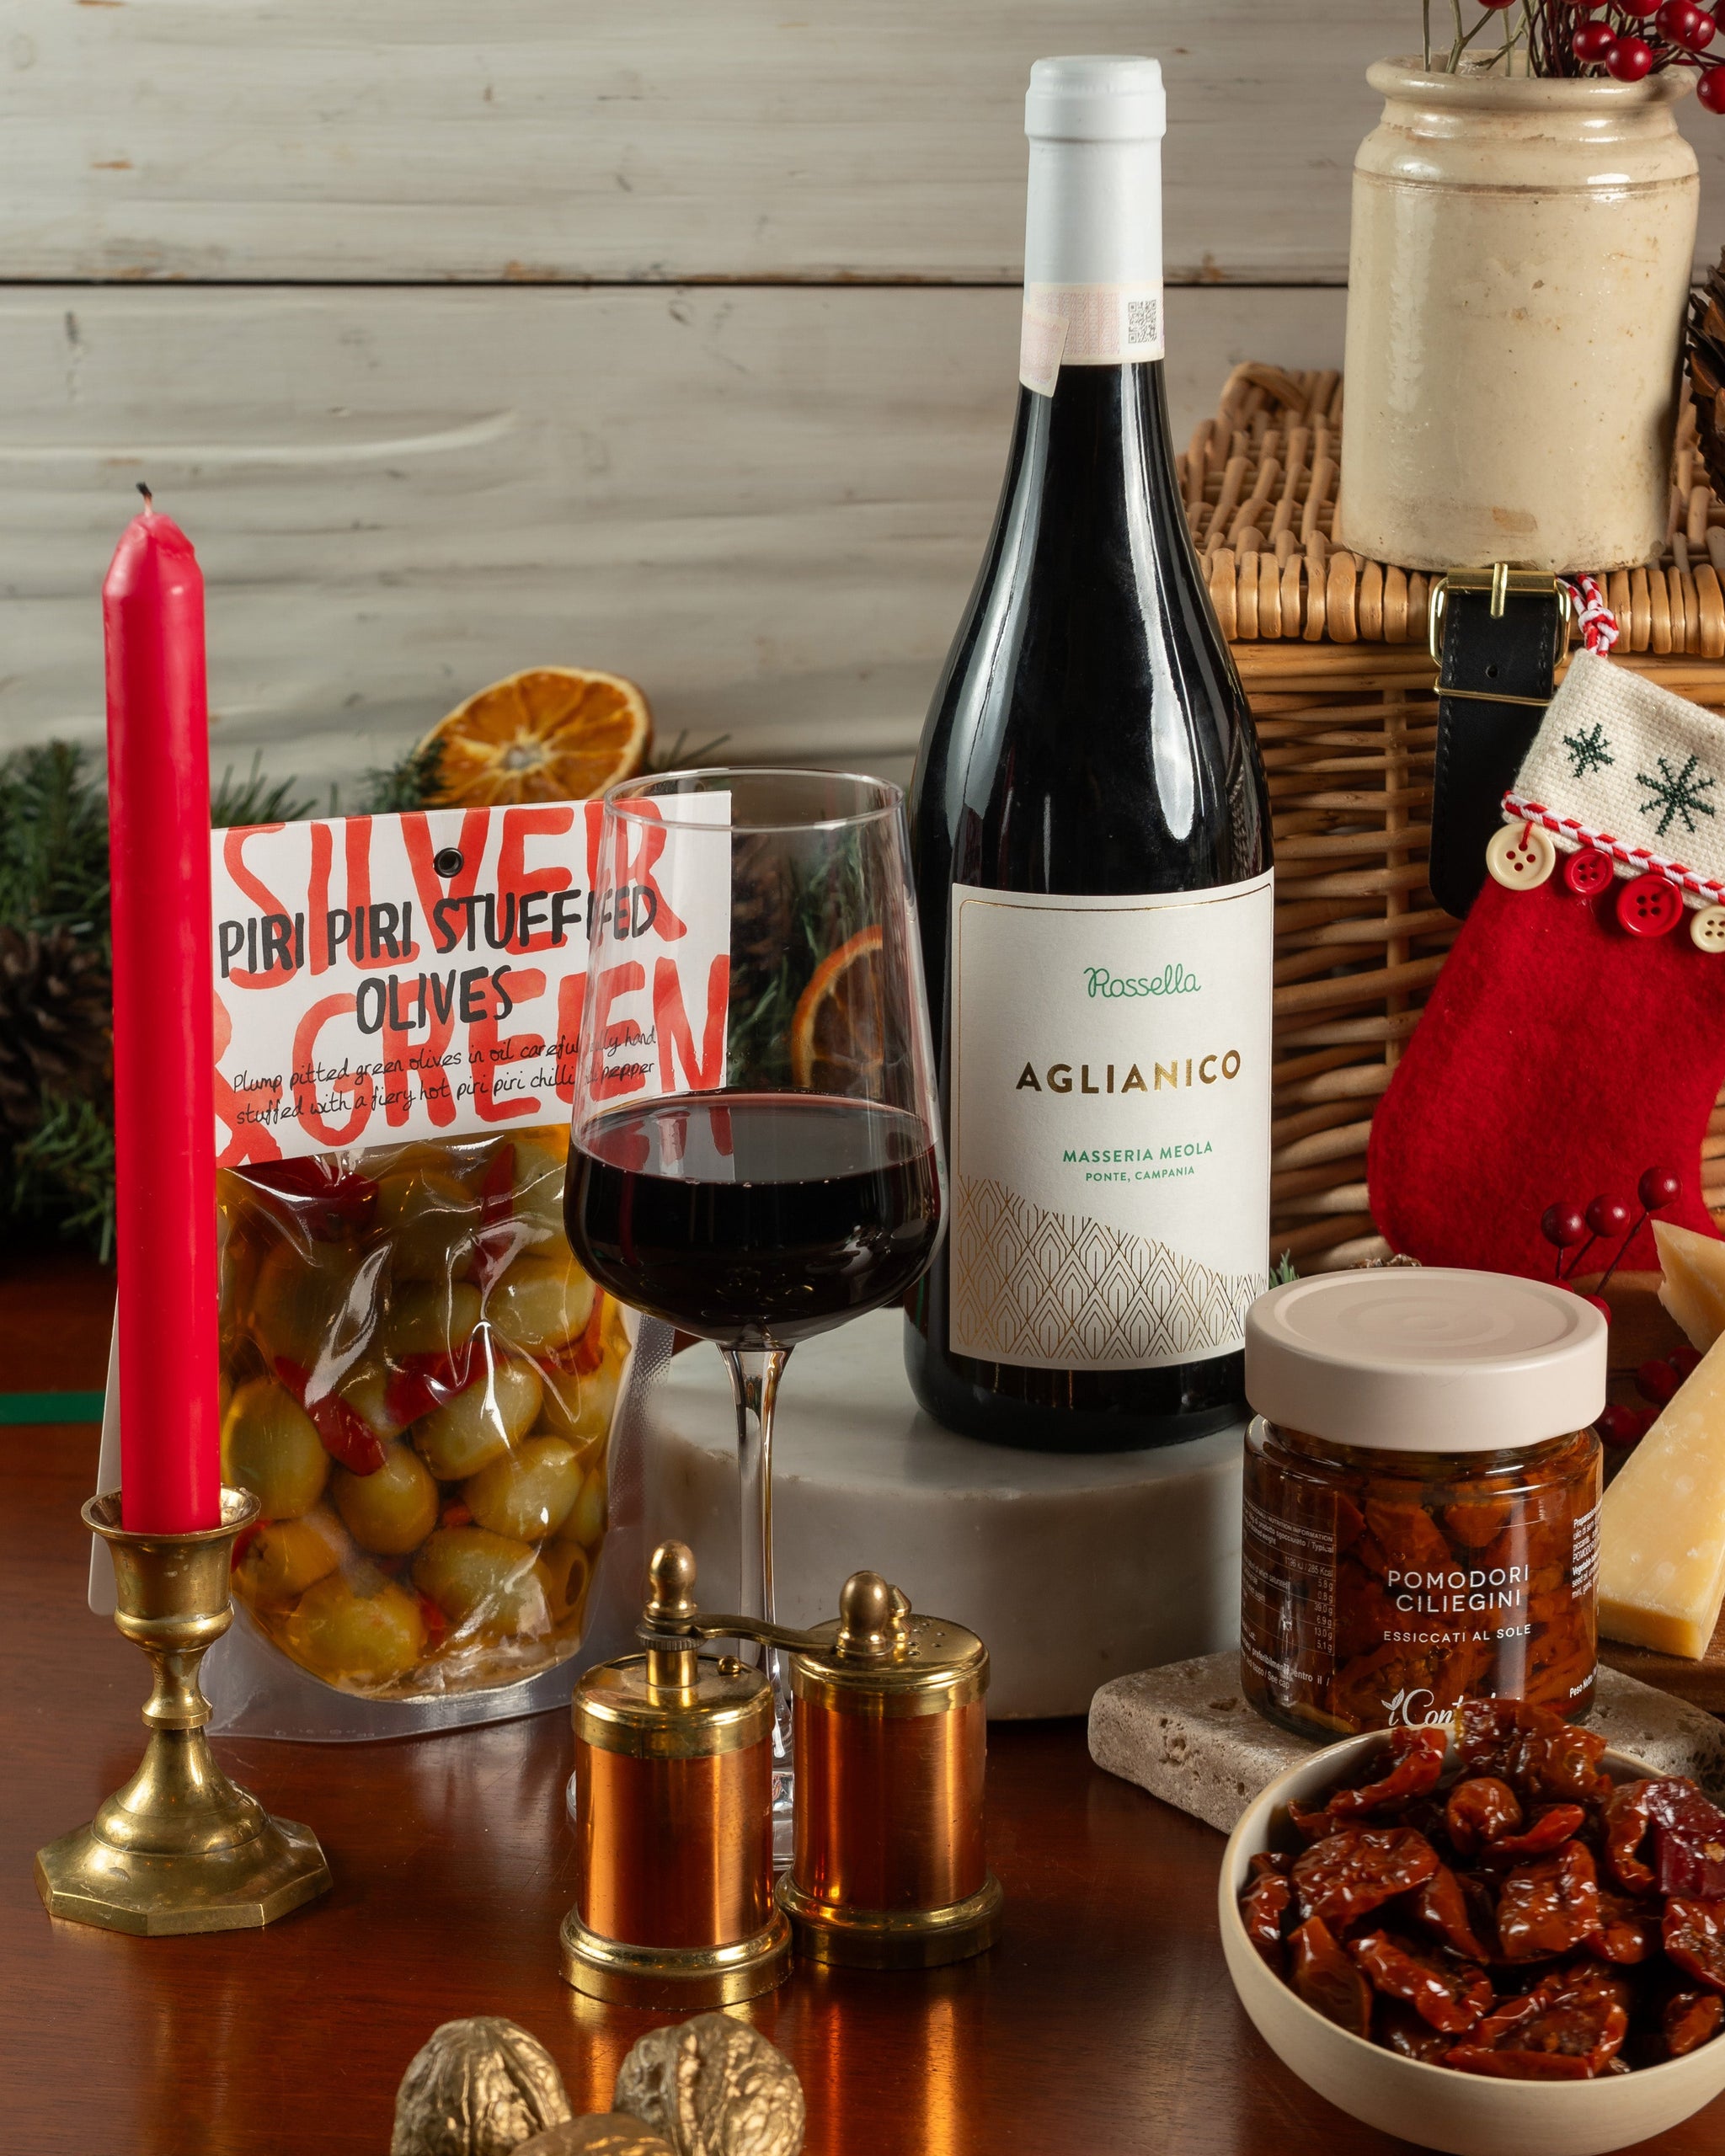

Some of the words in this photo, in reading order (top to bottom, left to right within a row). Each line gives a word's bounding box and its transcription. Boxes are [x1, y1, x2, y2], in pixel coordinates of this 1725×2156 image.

[223, 797, 686, 990] SILVER
[219, 912, 304, 979] PIRI
[327, 901, 412, 966] PIRI
[1083, 963, 1201, 998] Rossella
[356, 964, 515, 1035] OLIVES
[233, 1070, 283, 1092] Plump
[290, 1057, 350, 1091] pitted
[355, 1059, 404, 1086] green
[409, 1047, 462, 1070] olives
[467, 1045, 484, 1064] in
[489, 1040, 514, 1063] oil
[623, 1025, 656, 1046] hand
[1016, 1049, 1241, 1094] AGLIANICO
[237, 1095, 304, 1125] stuffed
[310, 1091, 351, 1115] with
[355, 1095, 367, 1109] a
[371, 1086, 416, 1111] fiery
[419, 1080, 451, 1101] hot
[457, 1075, 489, 1100] piri
[493, 1071, 526, 1096] piri
[530, 1065, 575, 1088] chilli
[601, 1062, 655, 1085] pepper
[1062, 1149, 1153, 1164] MASSERIA
[1160, 1140, 1213, 1160] MEOLA
[1086, 1171, 1131, 1184] PONTE,
[1135, 1166, 1194, 1181] CAMPANIA
[1292, 1526, 1333, 1542] INFORMATION
[1311, 1541, 1334, 1553] Typical
[1388, 1565, 1530, 1589] POMODORI
[1396, 1588, 1521, 1613] CILIEGINI
[1384, 1630, 1466, 1643] ESSICCATI
[1472, 1631, 1491, 1641] AL
[1496, 1624, 1532, 1639] SOLE
[1294, 1668, 1313, 1683] entro
[1317, 1675, 1322, 1685] il
